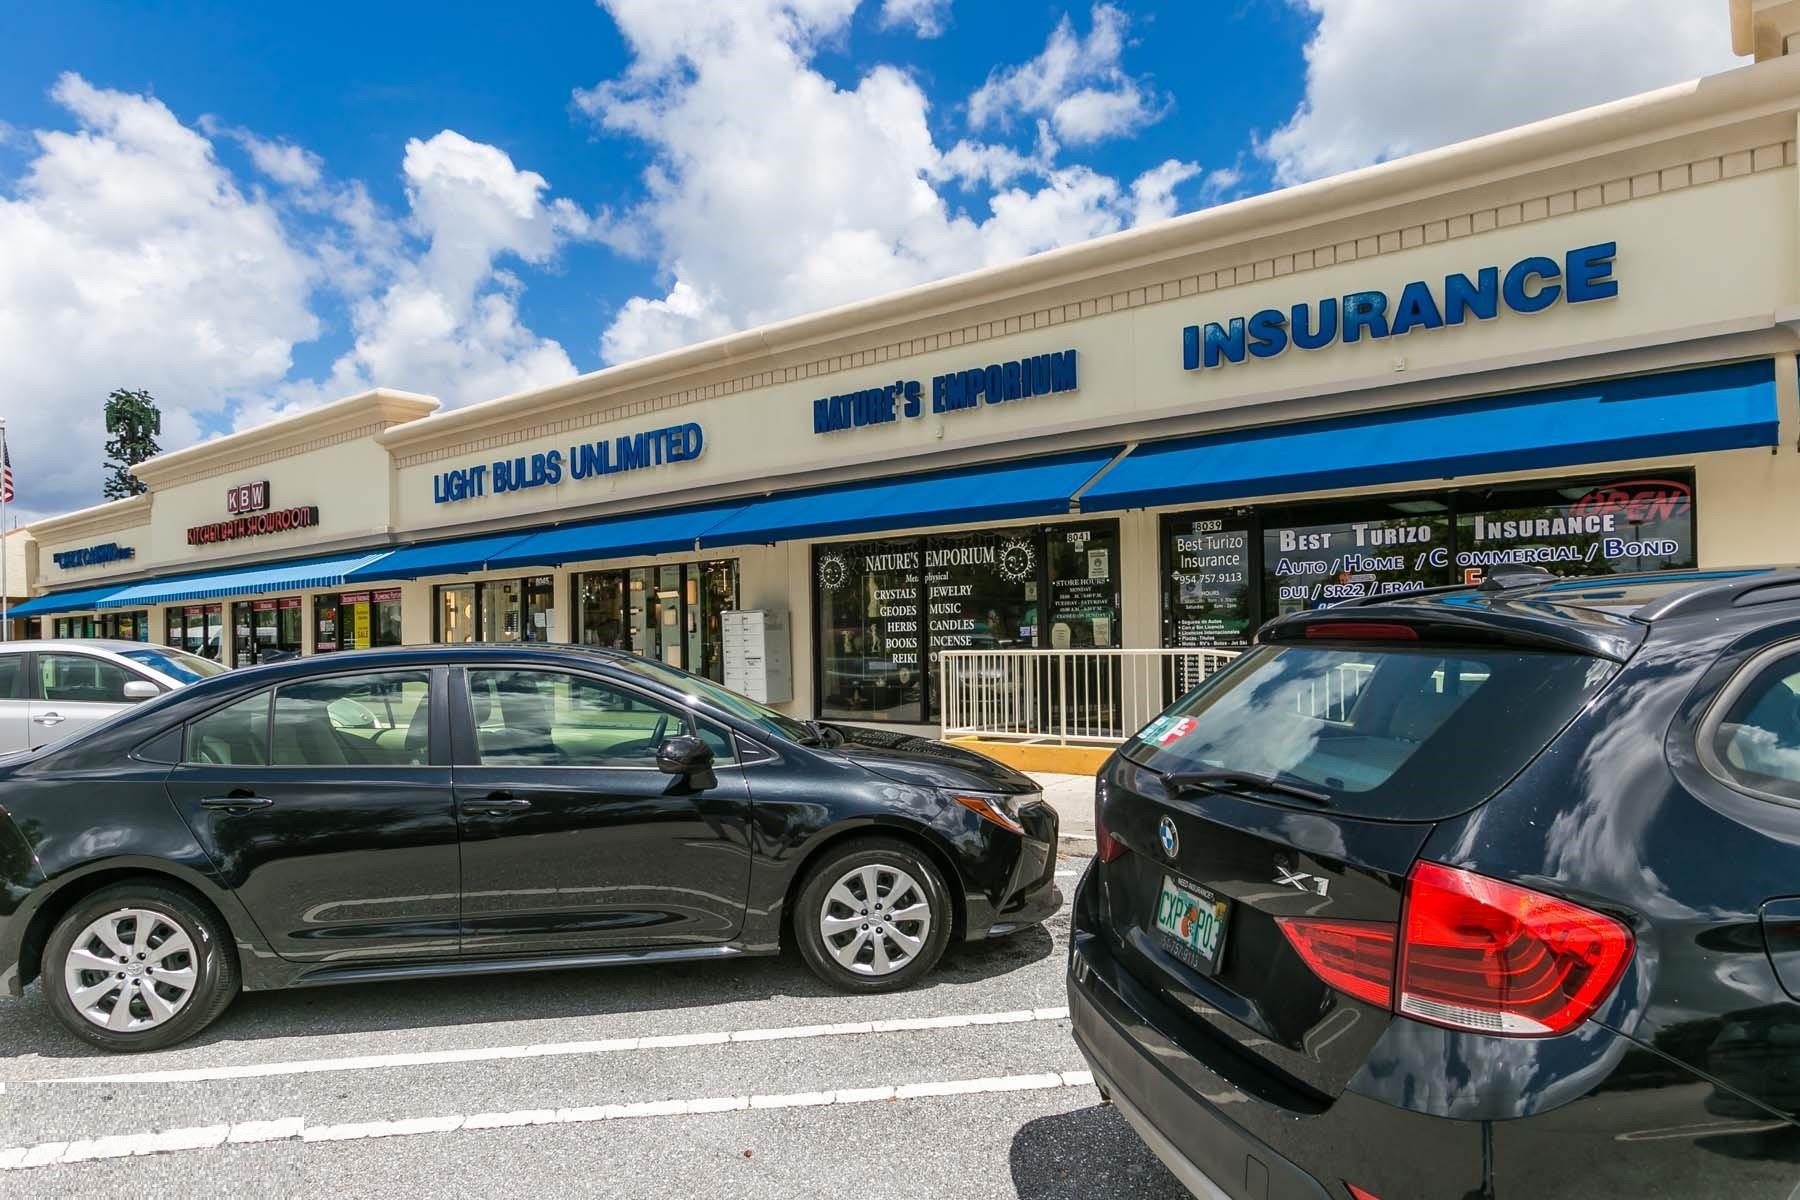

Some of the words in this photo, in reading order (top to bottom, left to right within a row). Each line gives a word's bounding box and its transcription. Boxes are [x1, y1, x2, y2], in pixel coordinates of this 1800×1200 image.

[1182, 241, 1619, 371] INSURANCE
[813, 380, 922, 434] NATURE'S
[932, 349, 1079, 414] EMPORIUM
[434, 465, 486, 504] LIGHT
[492, 450, 562, 494] BULBS
[570, 422, 704, 480] UNLIMITED
[228, 484, 264, 511] KBW
[1577, 490, 1681, 522] OPEN
[187, 524, 220, 545] KITCHEN
[247, 506, 316, 536] SHOWROOM
[1196, 521, 1222, 531] 8039
[1279, 530, 1332, 552] BEST
[1351, 523, 1431, 547] TURIZO
[1473, 514, 1615, 540] INSURANCE
[1067, 532, 1089, 542] 8041
[1177, 538, 1203, 552] Best
[1205, 535, 1243, 550] Turizo
[865, 552, 919, 572] NATURE'S
[925, 546, 995, 568] EMPORIUM
[1181, 554, 1240, 569] Insurance
[1276, 558, 1327, 575] AUTO
[1343, 554, 1404, 573] HOME
[1603, 538, 1679, 558] BOND
[1055, 579, 1080, 587] STORE
[1080, 577, 1105, 586] HOURS
[1180, 572, 1242, 585] 954.757.9113
[874, 588, 917, 600] CRYSTALS
[929, 584, 973, 600] JEWELRY
[1279, 586, 1308, 599] DUI
[1323, 583, 1365, 599] SR22
[880, 605, 917, 617] GEODES
[929, 603, 962, 615] MUSIC
[887, 621, 917, 632] HERBS
[929, 619, 975, 631] CANDLES
[885, 638, 918, 649] BOOKS
[929, 635, 973, 647] INCENSE
[892, 653, 918, 664] REIKI
[1272, 865, 1329, 897] X1
